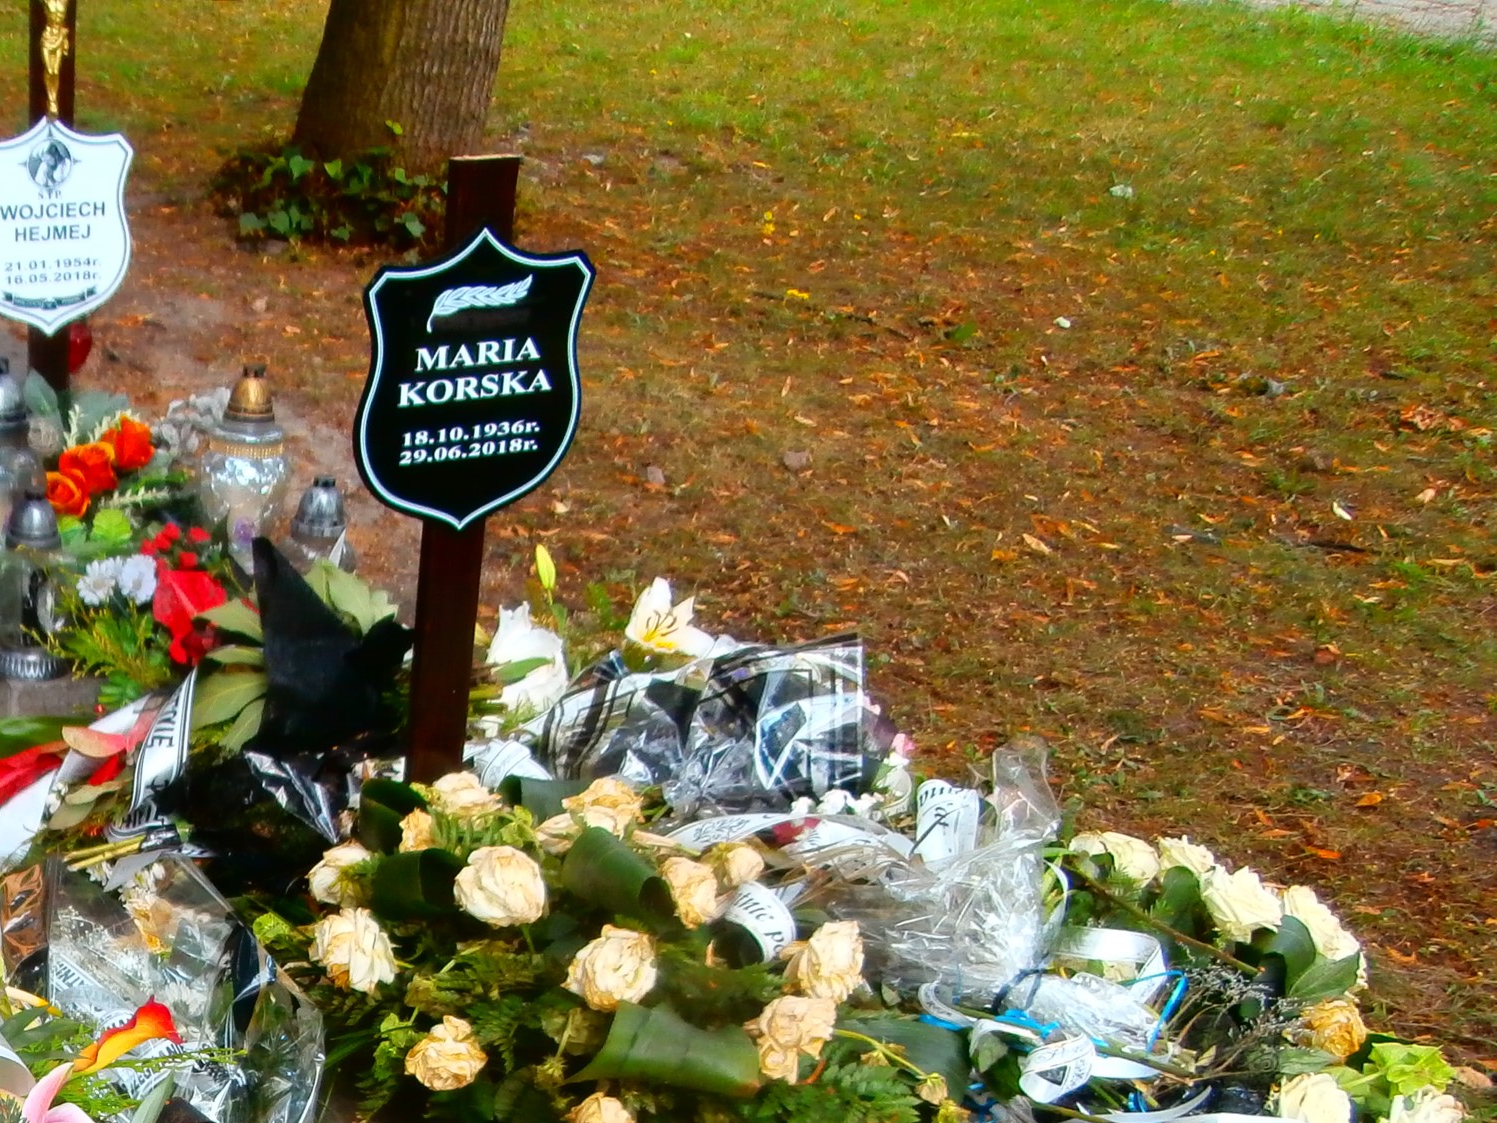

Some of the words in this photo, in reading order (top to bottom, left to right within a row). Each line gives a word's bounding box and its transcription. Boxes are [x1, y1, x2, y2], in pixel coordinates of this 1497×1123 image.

[0, 201, 106, 220] WOJCIECH
[14, 224, 91, 242] HEJMEJ
[414, 337, 541, 372] MARIA
[397, 369, 552, 408] KORSKA
[402, 419, 540, 447] 18.10.1936r.
[399, 438, 538, 466] 29.06.2018r.
